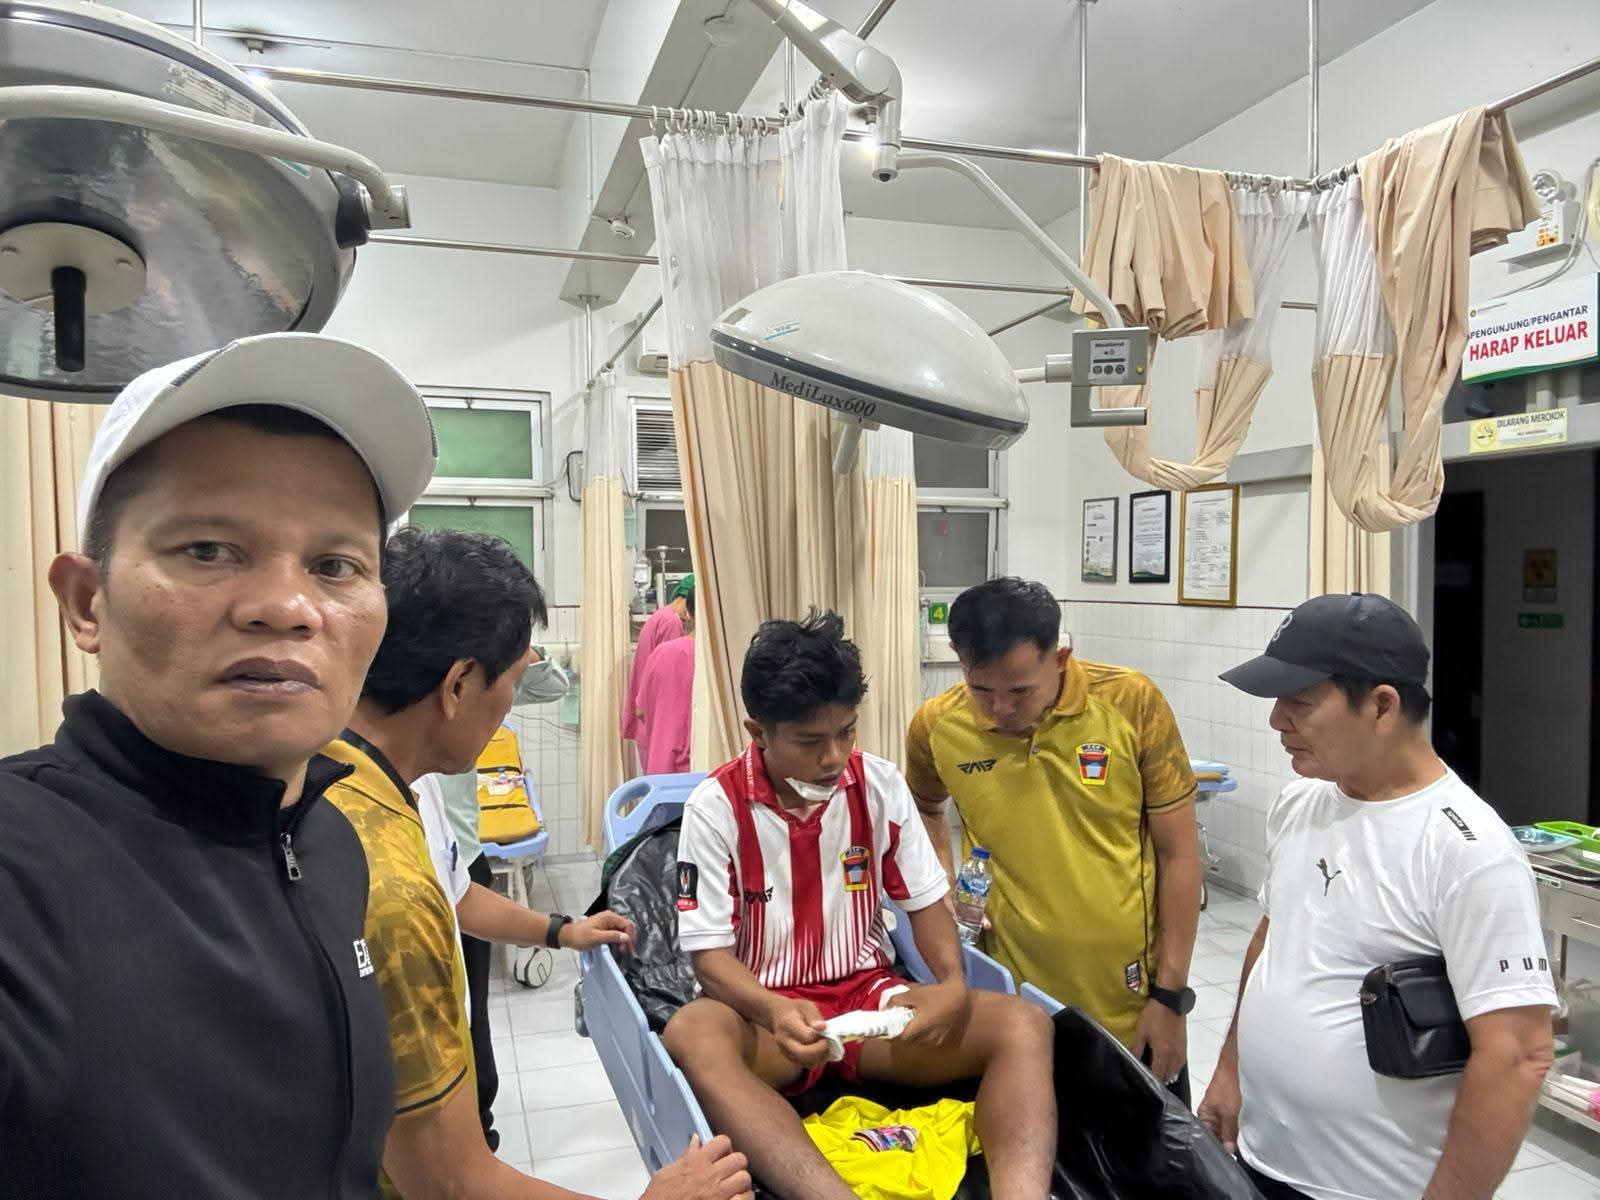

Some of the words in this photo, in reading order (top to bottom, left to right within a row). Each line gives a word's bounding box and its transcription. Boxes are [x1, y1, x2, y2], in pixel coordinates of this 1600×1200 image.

[1470, 305, 1588, 339] PENGUNJUNG/PENGANTAR
[1469, 334, 1520, 362] HARAP
[1524, 320, 1588, 351] KELUAR
[770, 372, 877, 417] MediLux600
[1496, 415, 1530, 428] DILARANG
[1530, 410, 1566, 423] MEROKOK
[933, 607, 944, 620] 4
[1499, 957, 1547, 972] PUM
